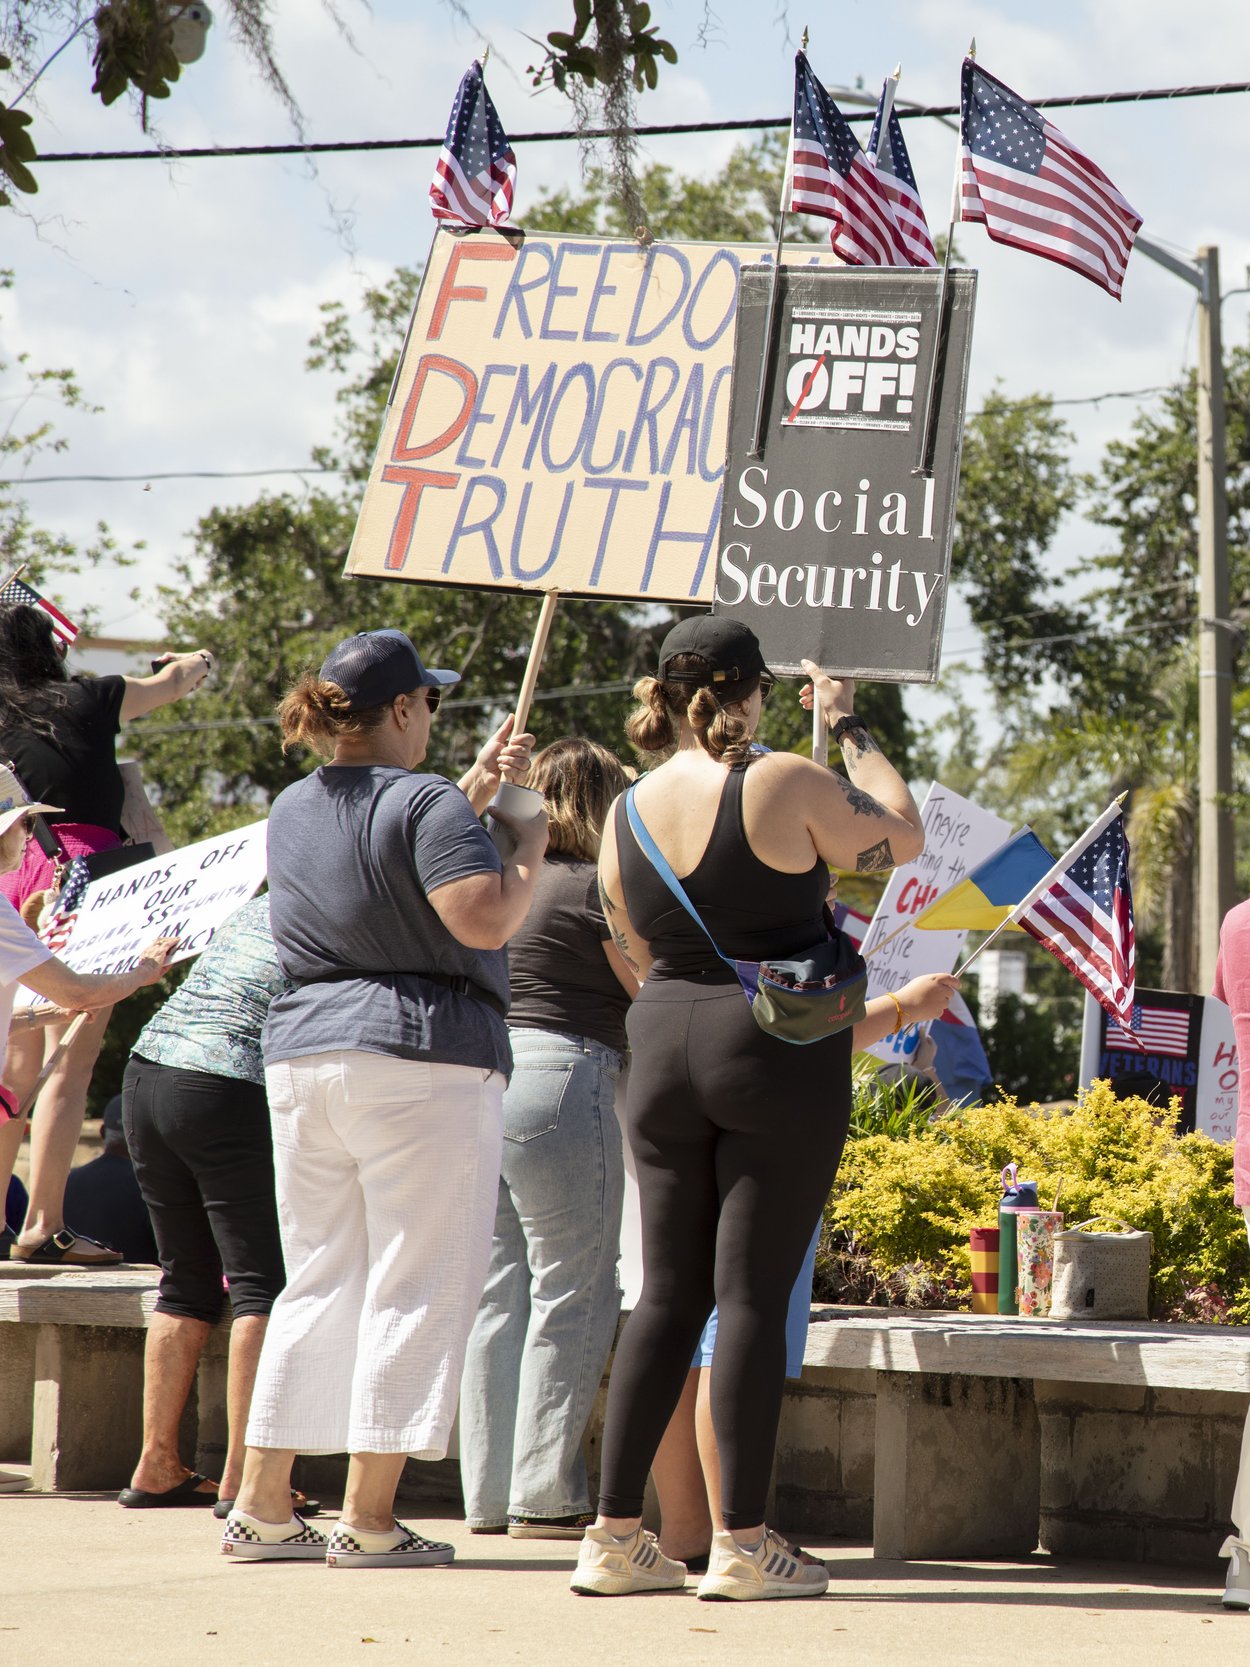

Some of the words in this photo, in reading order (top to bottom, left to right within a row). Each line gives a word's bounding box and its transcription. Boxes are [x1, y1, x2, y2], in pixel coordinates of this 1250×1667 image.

[426, 241, 741, 352] FREEDO
[790, 324, 920, 359] HANDS
[390, 352, 733, 483] DEMOCRAC
[786, 359, 917, 414] OFF!
[381, 465, 726, 597] TRUTH
[733, 466, 936, 541] Social
[715, 543, 944, 627] Security
[924, 797, 970, 849] They're
[91, 864, 177, 911] HANDS
[200, 839, 249, 870] OFF
[143, 878, 197, 910] OUR
[908, 844, 943, 884] ting
[1100, 1052, 1197, 1086] VETERANS
